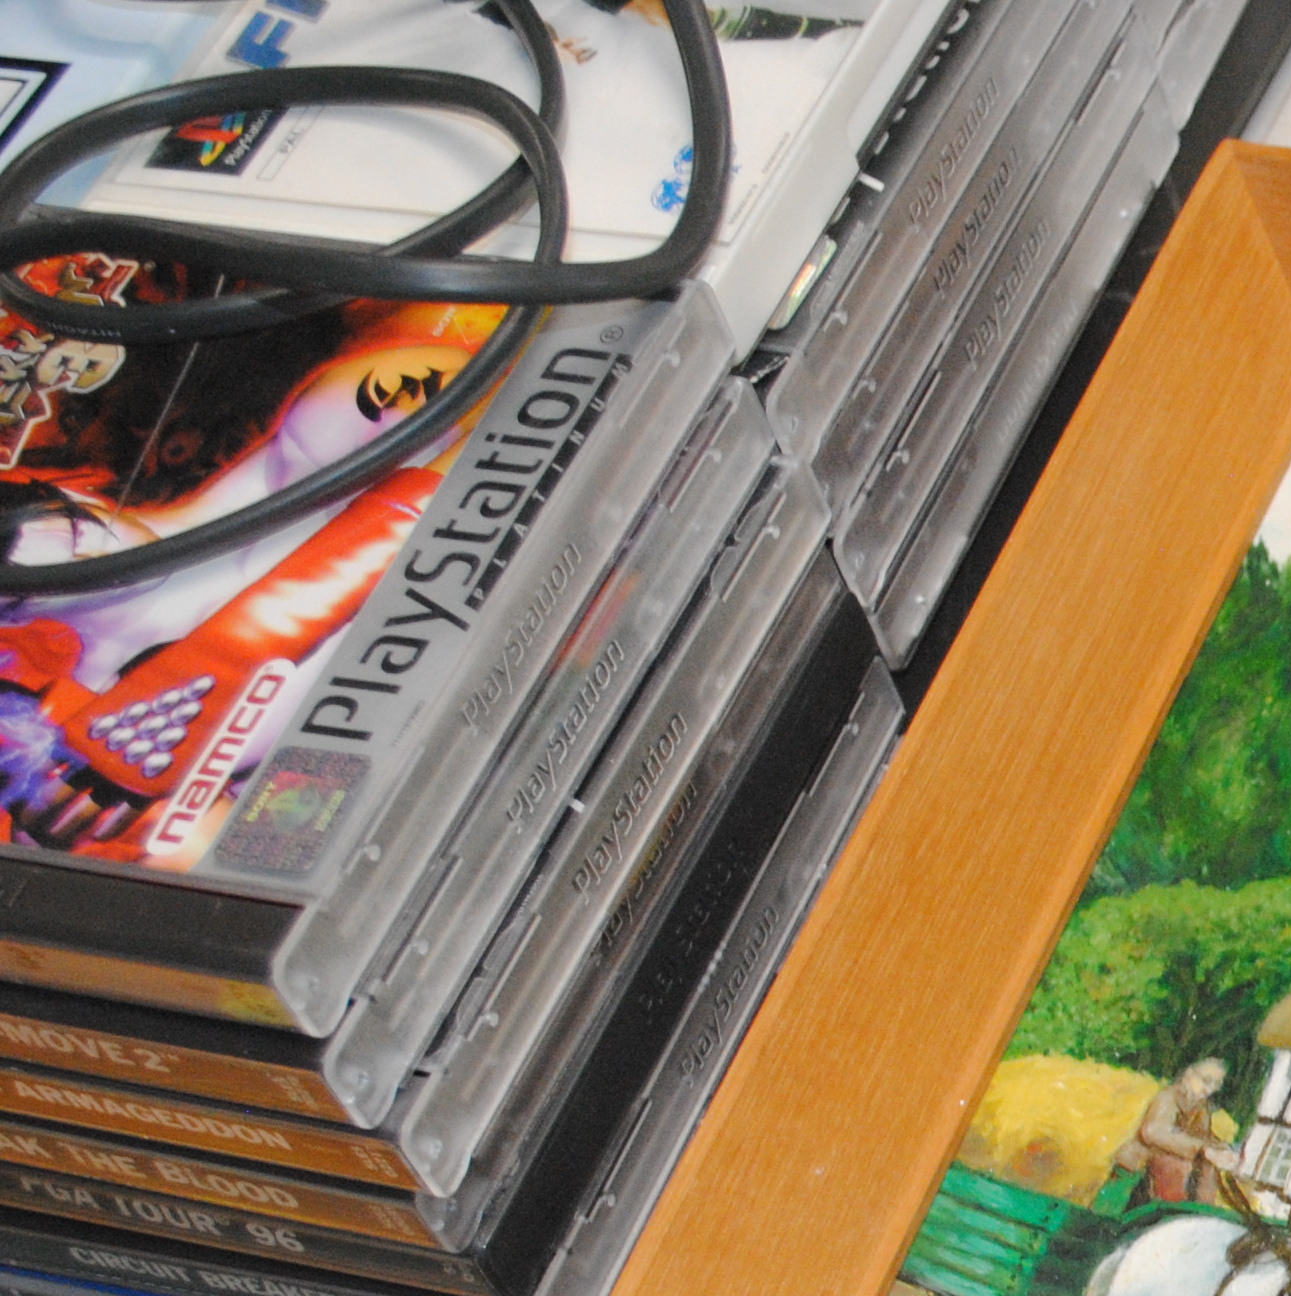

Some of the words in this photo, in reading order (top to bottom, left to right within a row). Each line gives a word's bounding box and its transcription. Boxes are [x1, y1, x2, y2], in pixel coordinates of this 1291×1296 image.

[301, 342, 611, 742] PlayStation
[460, 541, 584, 737] PlayStation
[156, 669, 287, 849] namco
[505, 637, 627, 835] PlayStation
[572, 710, 690, 906] PlayStation
[14, 1080, 293, 1151] ARMAGEDDON
[57, 1141, 147, 1178] THE
[153, 1159, 299, 1208] BLOOD
[69, 1246, 191, 1283] CIRCUIT
[246, 1222, 305, 1252] 96
